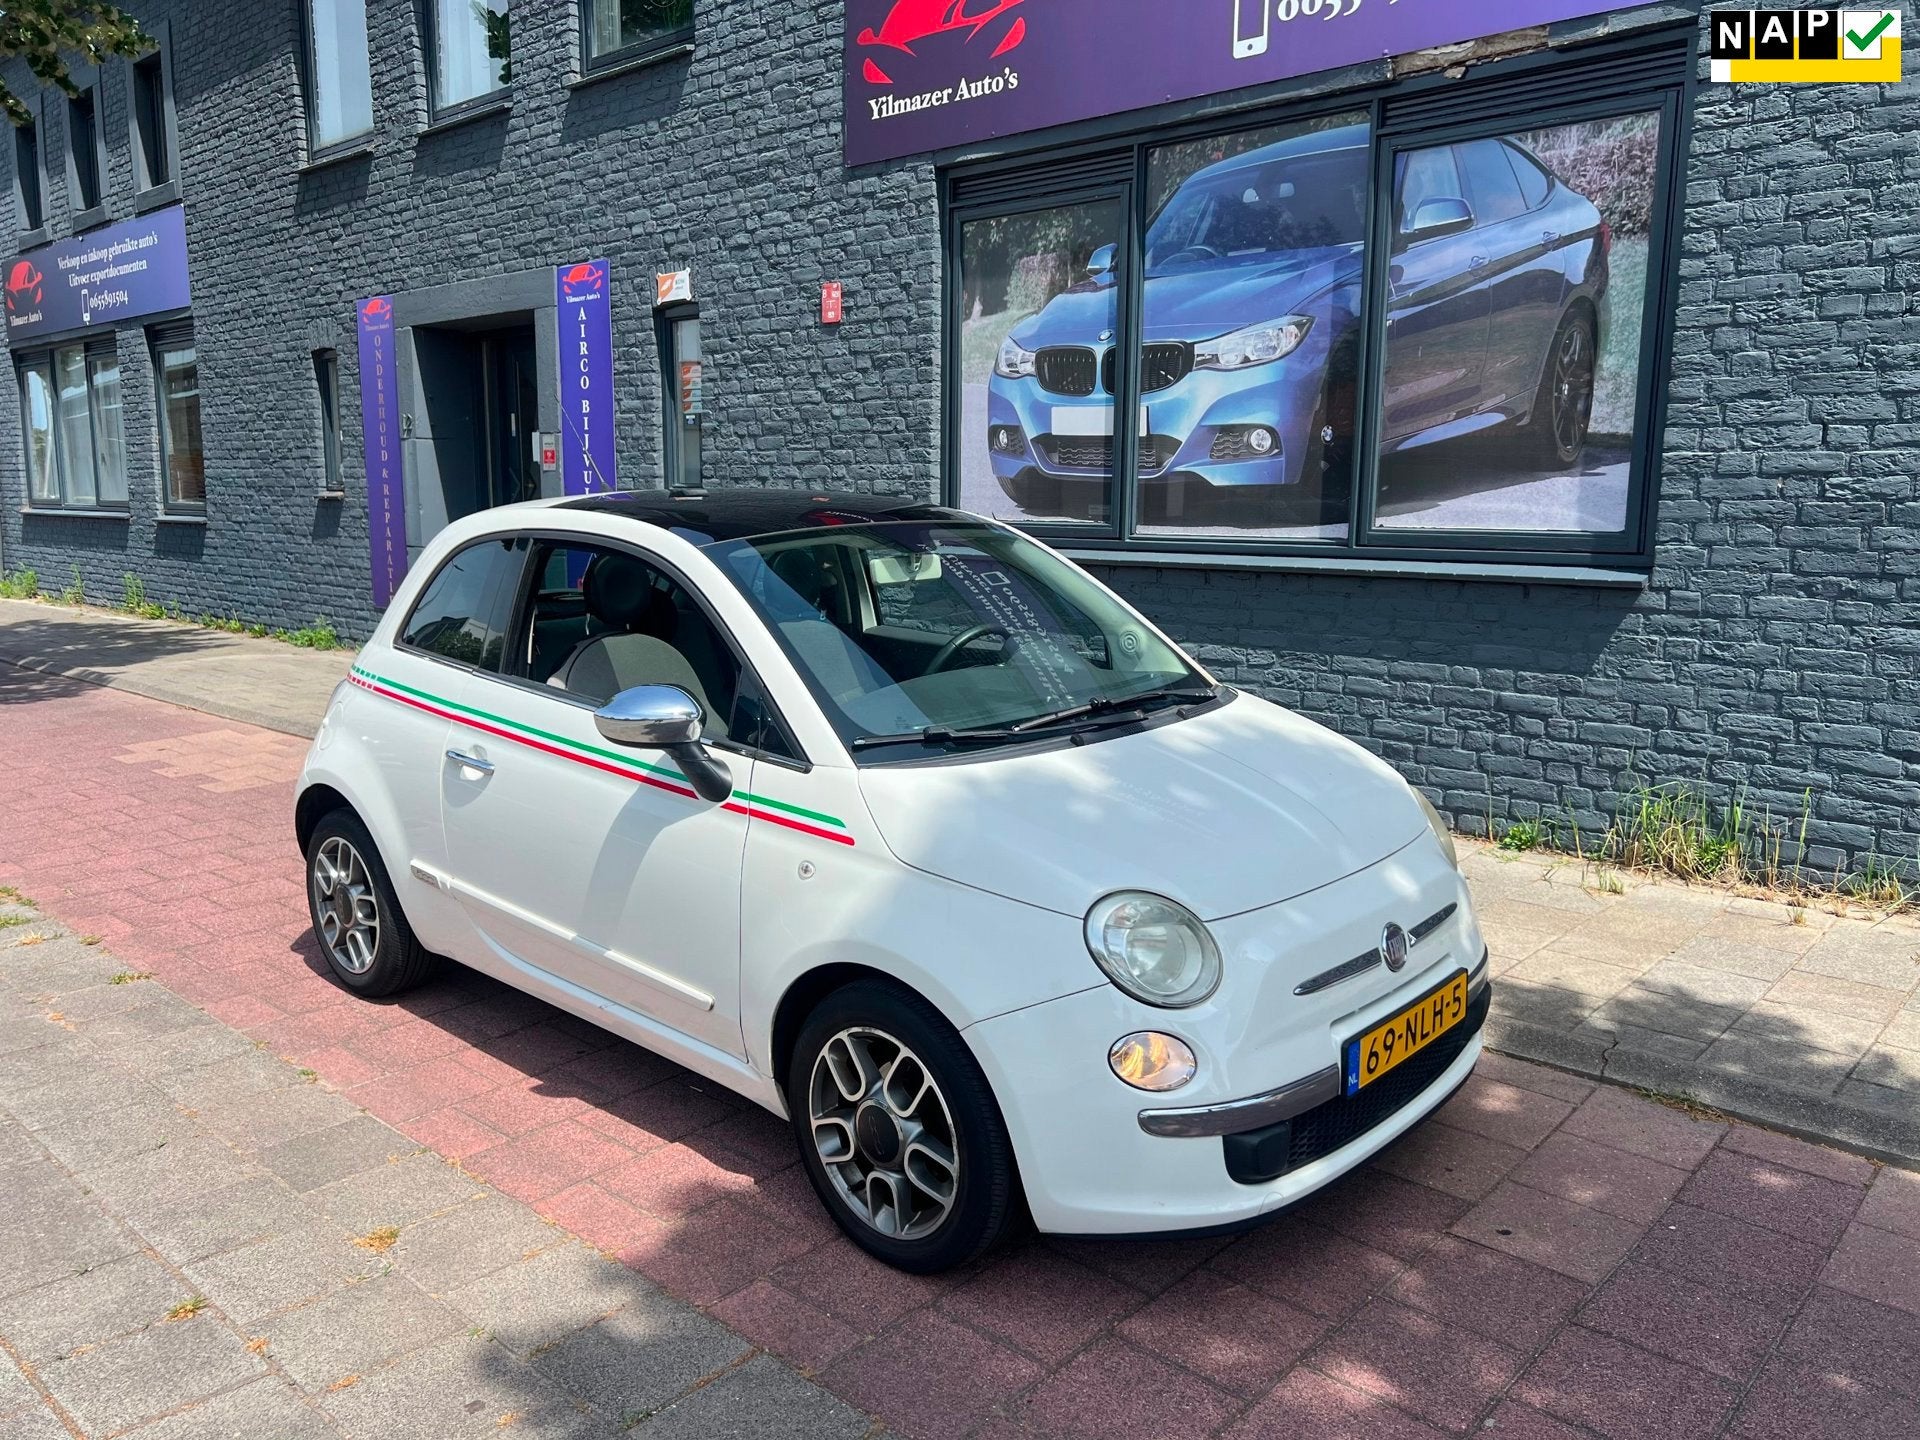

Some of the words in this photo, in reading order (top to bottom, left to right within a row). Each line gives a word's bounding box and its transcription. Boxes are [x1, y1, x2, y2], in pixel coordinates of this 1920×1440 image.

[868, 87, 952, 120] Yilmazer
[955, 67, 1018, 101] Auto's
[58, 254, 80, 270] Verkoop
[81, 254, 88, 264] en
[88, 247, 108, 262] inkoop
[108, 237, 138, 261] gebruikte
[139, 230, 158, 249] auto's
[68, 273, 90, 287] Uitvoer
[90, 259, 147, 285] exportdocumenten
[89, 289, 128, 310] 0655891504
[578, 306, 590, 390] AIRCO
[374, 335, 388, 462] ONDERHOUD
[382, 468, 389, 479] &
[1366, 982, 1461, 1074] 69-NLH-5
[1348, 1072, 1358, 1086] NL
